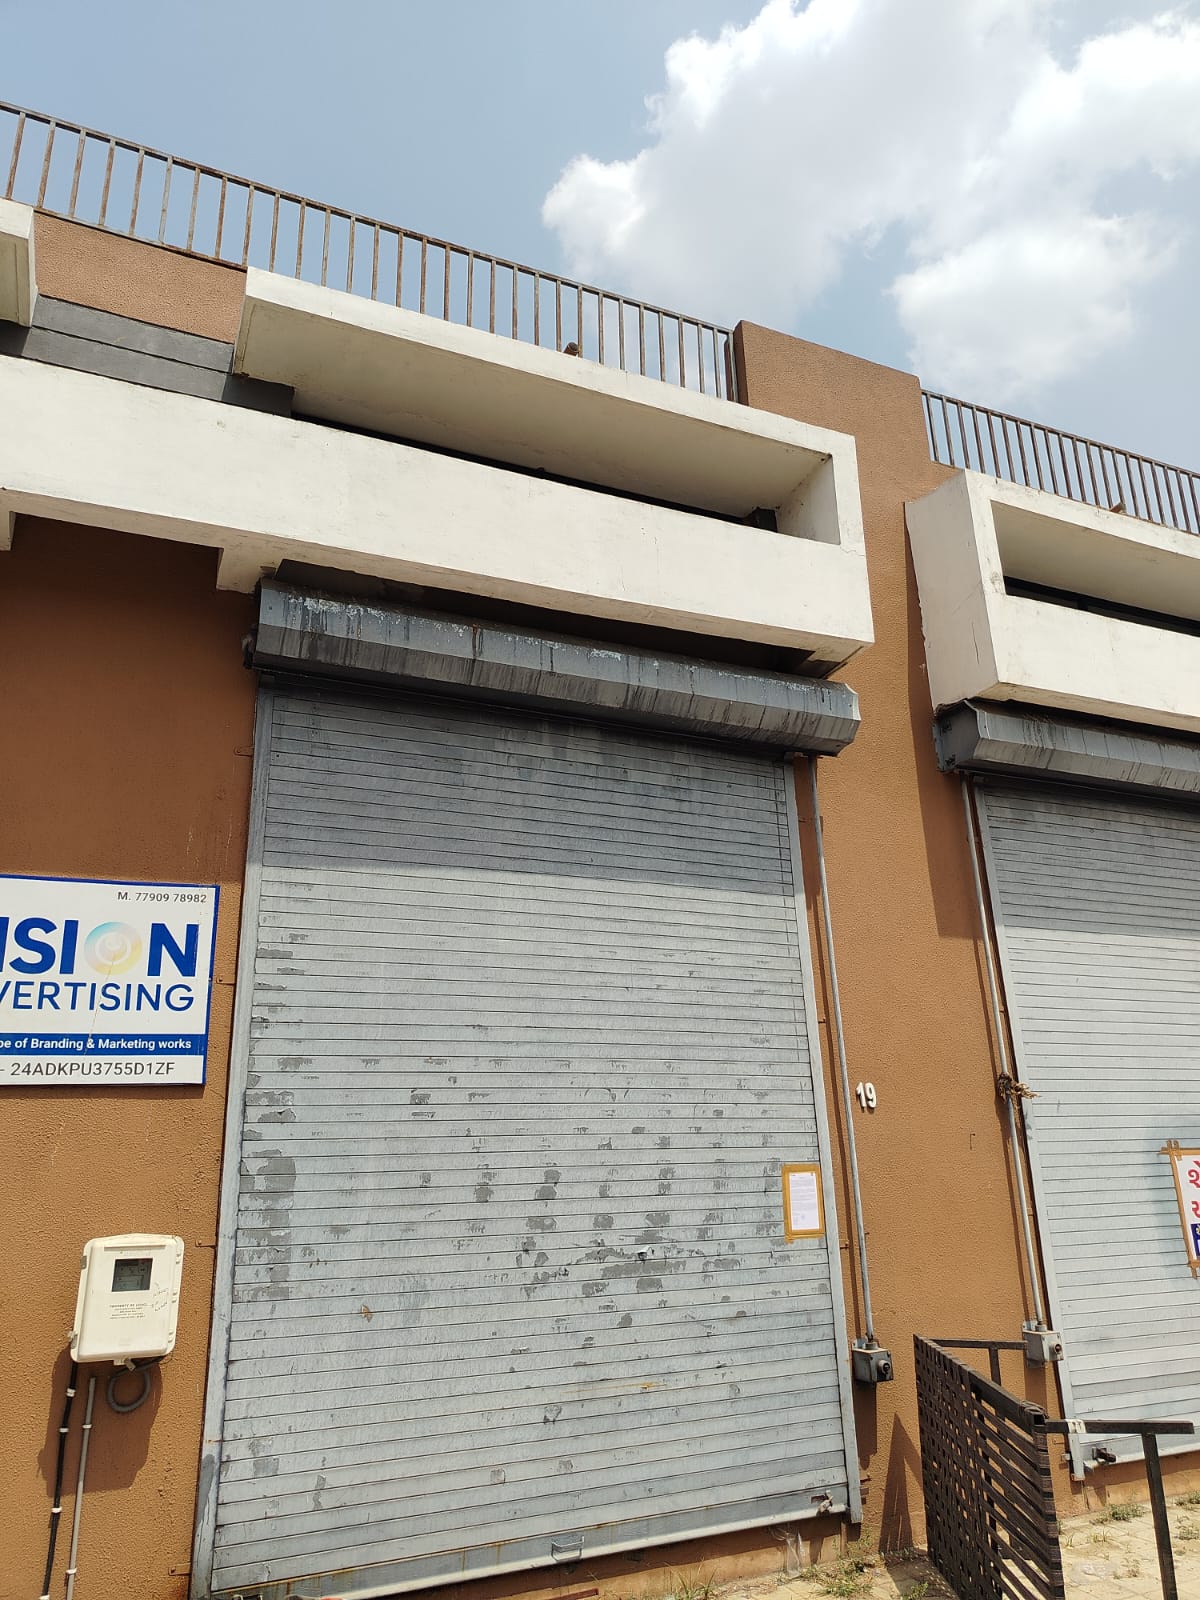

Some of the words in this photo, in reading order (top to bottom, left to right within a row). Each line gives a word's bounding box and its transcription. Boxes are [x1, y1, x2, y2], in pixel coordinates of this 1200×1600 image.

[117, 891, 131, 901] M.
[135, 892, 170, 902] 77909
[173, 893, 207, 903] 78982
[15, 1038, 28, 1049] of
[31, 1038, 83, 1051] Branding
[86, 1038, 95, 1049] &
[98, 1038, 155, 1051] Marketing
[158, 1038, 192, 1049] works
[10, 1062, 175, 1076] 24ADKPU3755D1ZF
[856, 1081, 877, 1108] 19
